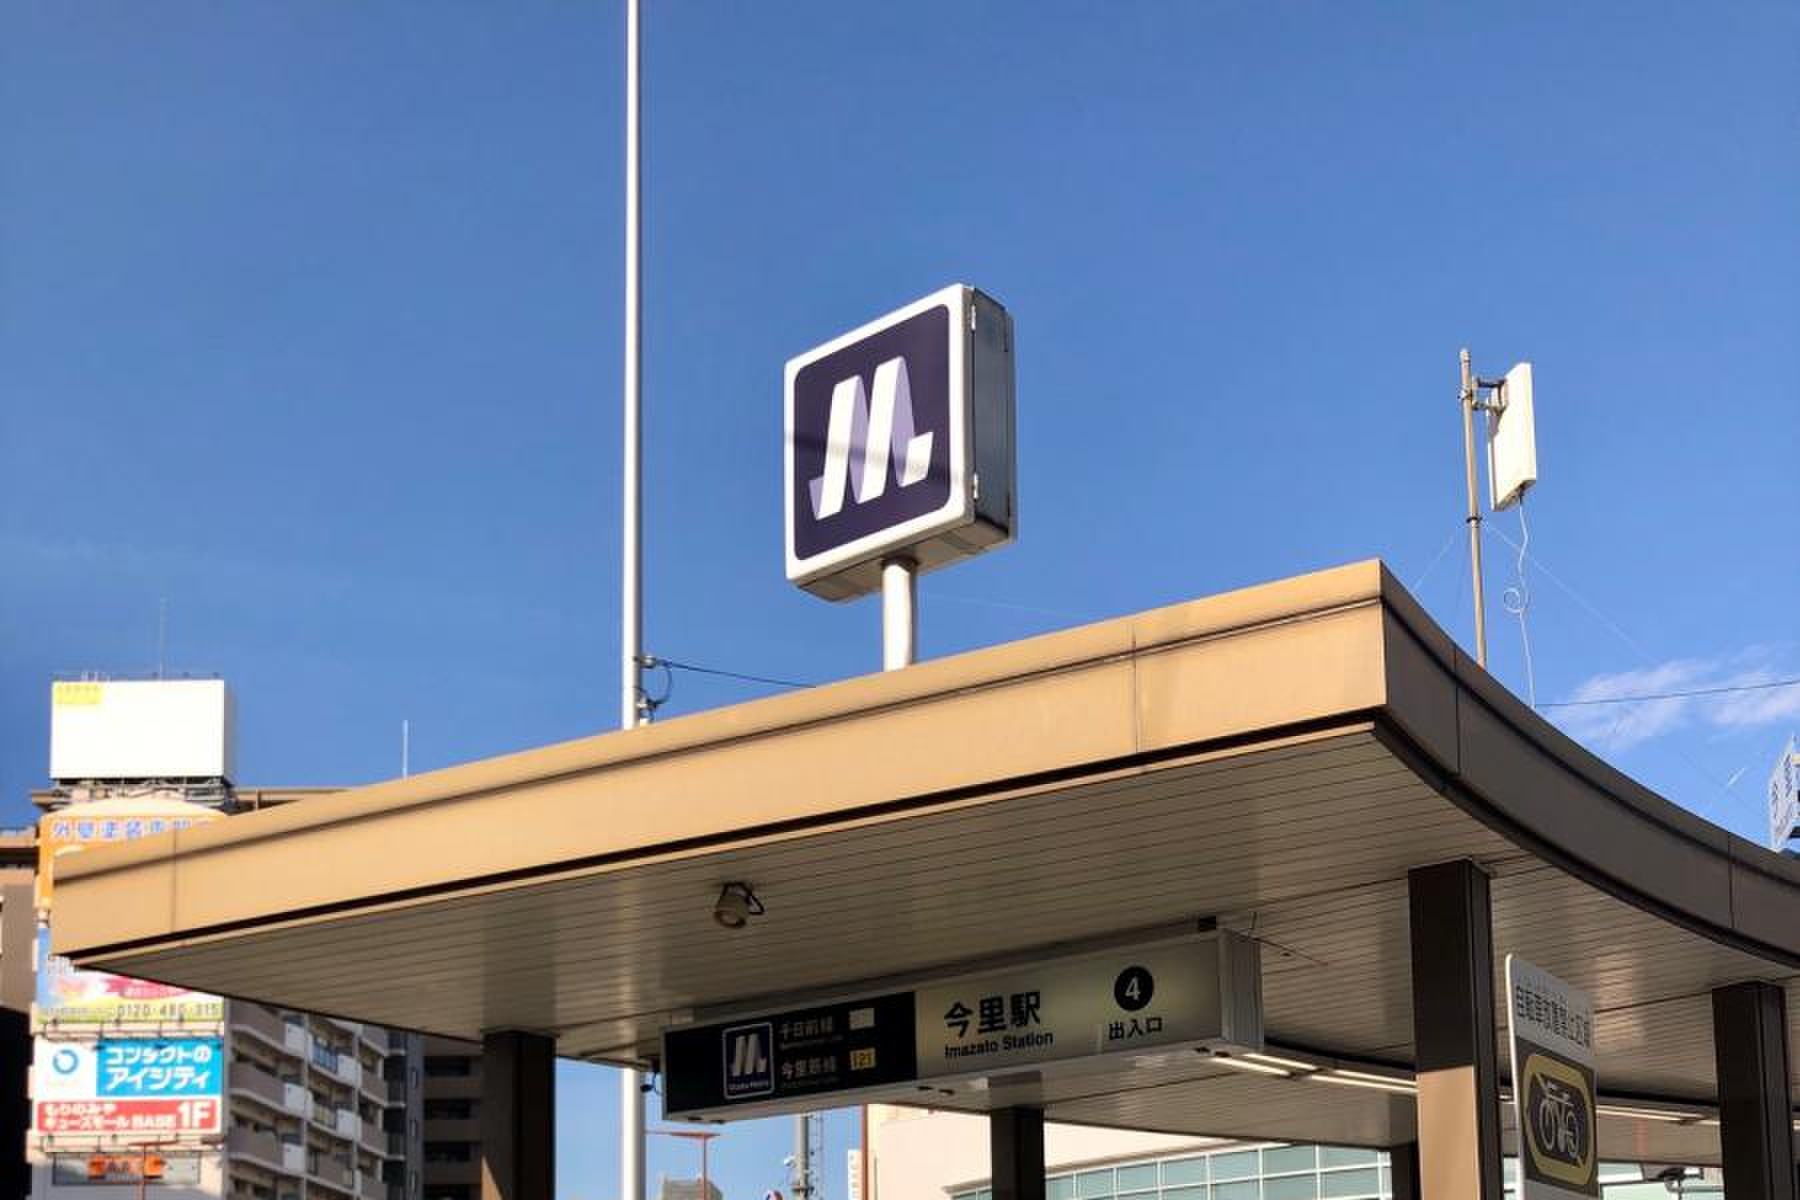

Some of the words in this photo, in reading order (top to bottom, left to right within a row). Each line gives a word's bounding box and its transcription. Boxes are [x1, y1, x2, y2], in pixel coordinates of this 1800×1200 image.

[1124, 977, 1141, 1001] 4
[944, 992, 1041, 1038] 今里駅
[1109, 1017, 1163, 1041] 出入口
[106, 1044, 211, 1065] コンタクトの
[945, 1040, 999, 1059] Imazato
[1003, 1031, 1054, 1052] Station
[178, 1102, 212, 1127] 1F
